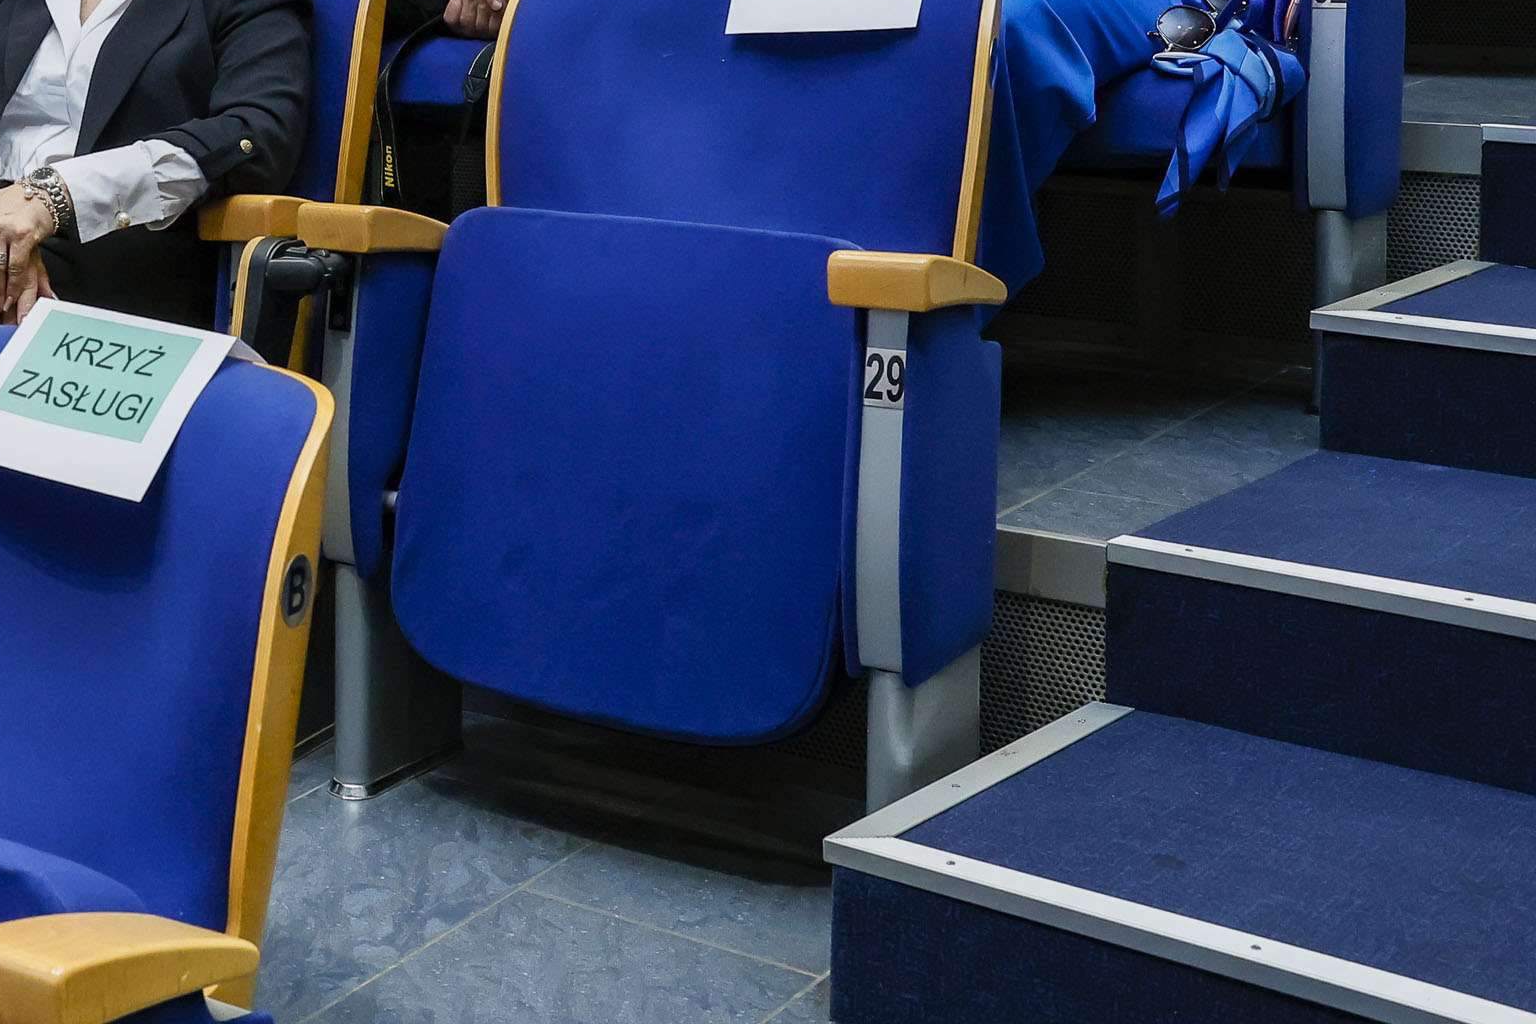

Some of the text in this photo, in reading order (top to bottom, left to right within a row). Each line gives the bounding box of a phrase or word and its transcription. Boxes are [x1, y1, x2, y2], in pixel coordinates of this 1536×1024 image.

[385, 145, 395, 188] Nikon
[52, 332, 167, 377] KRZYŻ
[864, 352, 905, 403] 29
[7, 369, 155, 424] ZASŁUGI
[287, 566, 305, 617] B
